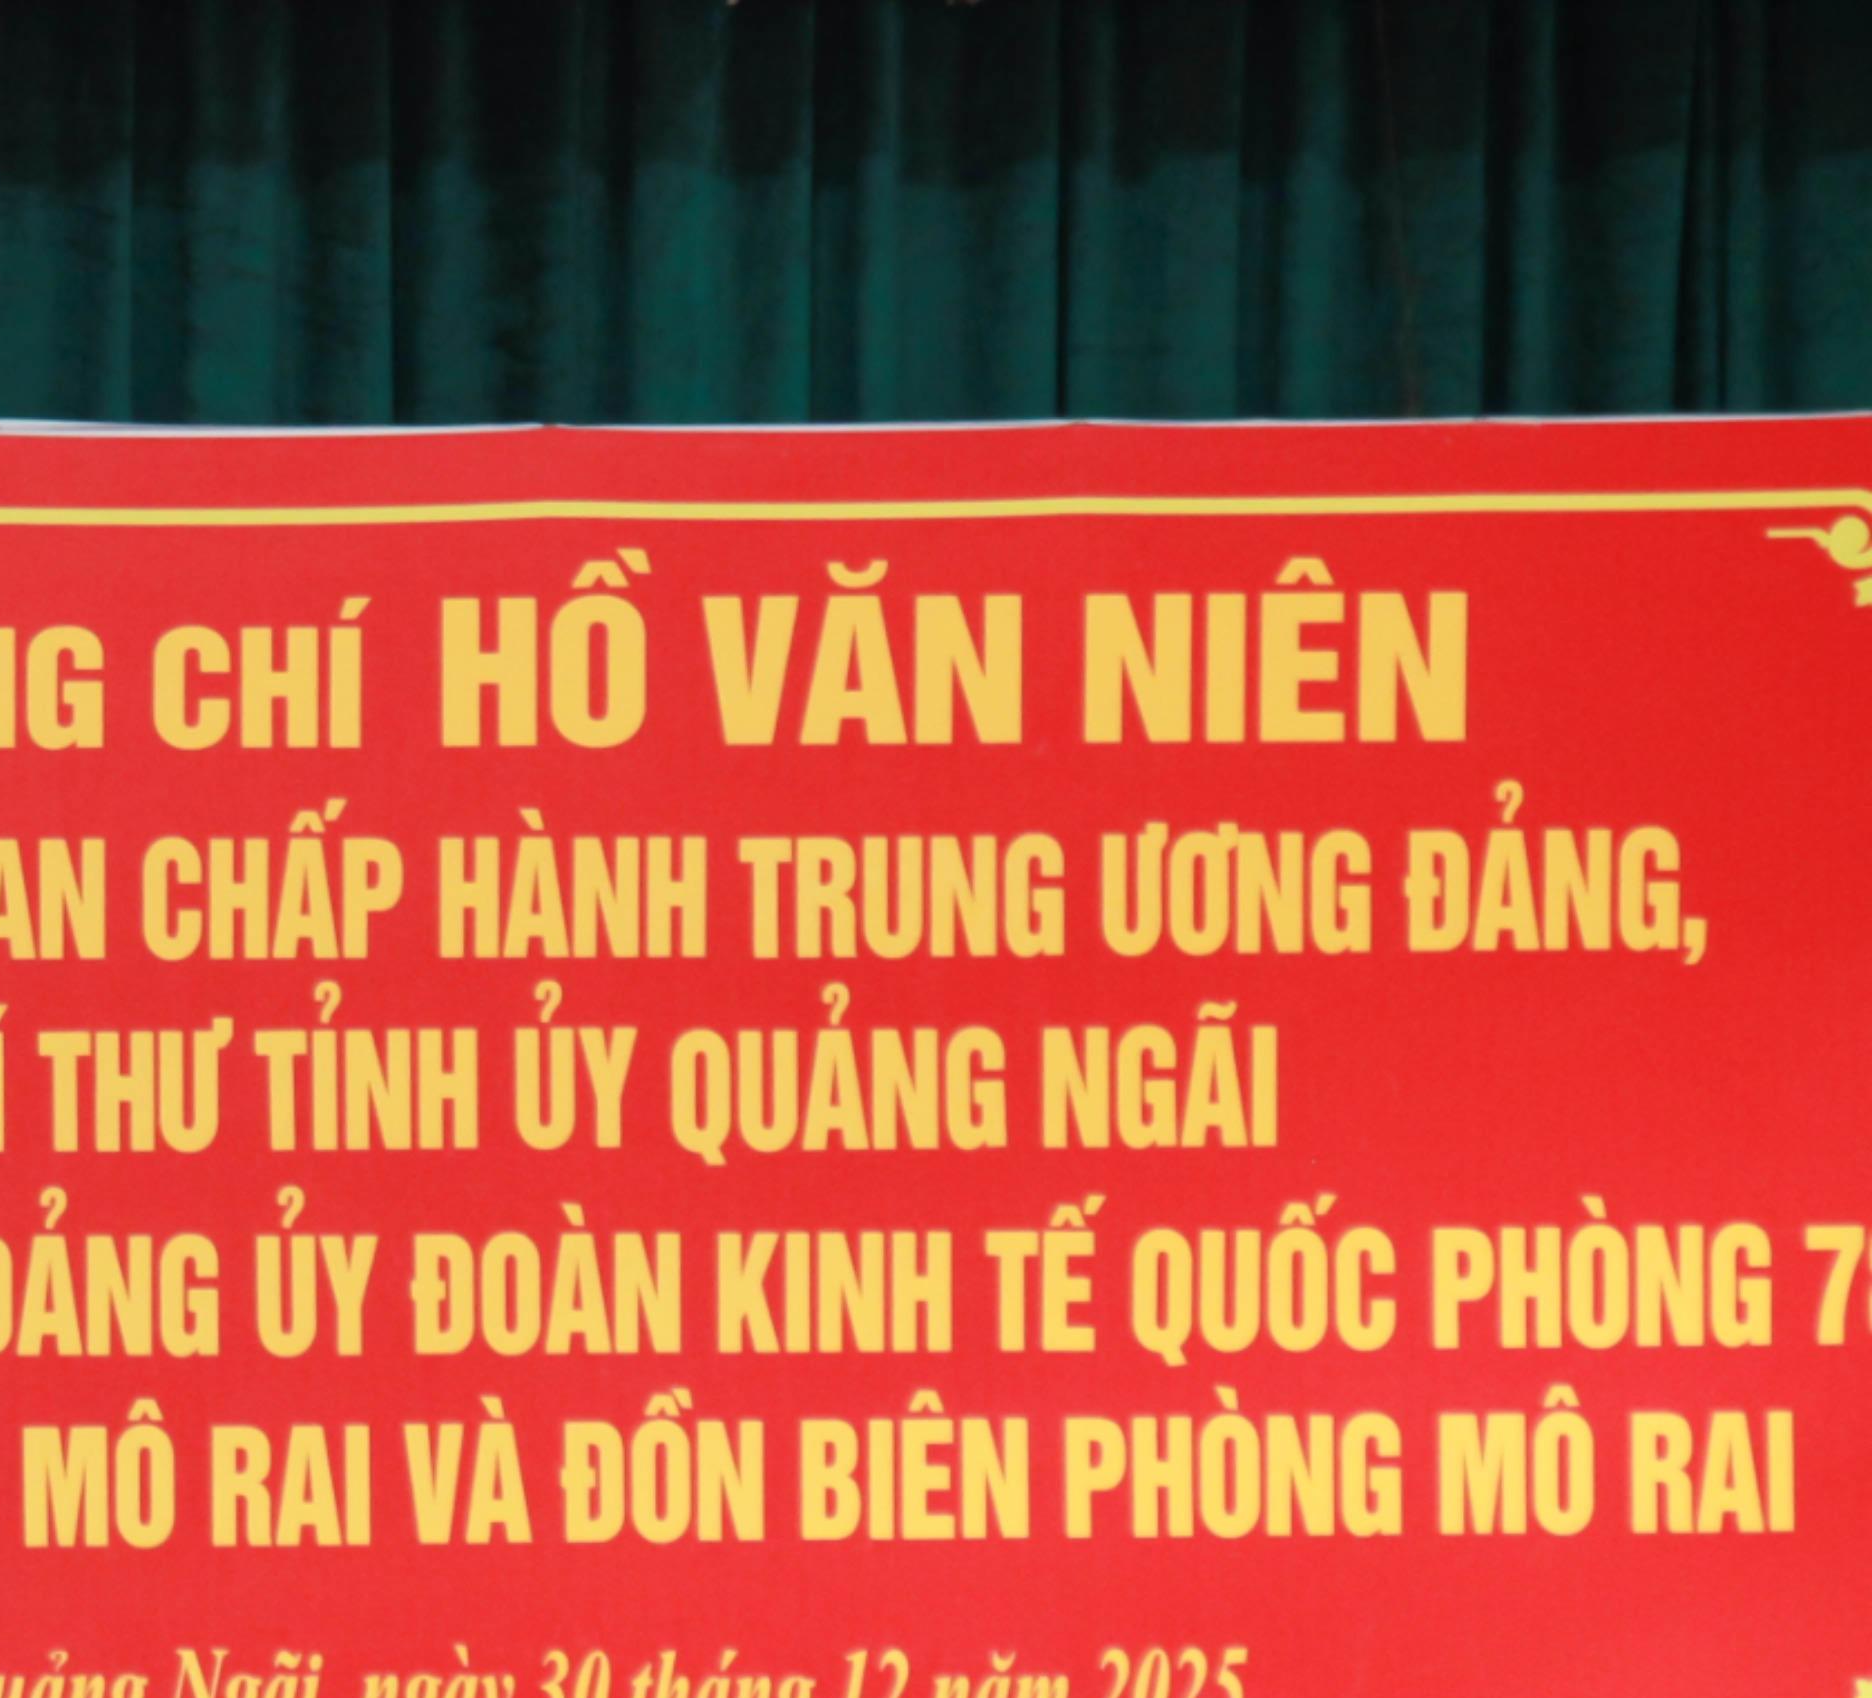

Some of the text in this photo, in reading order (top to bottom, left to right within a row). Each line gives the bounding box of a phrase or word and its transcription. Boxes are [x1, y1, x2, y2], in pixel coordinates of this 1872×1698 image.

[153, 597, 369, 750] CHÍ
[442, 548, 650, 748] HỒ
[703, 560, 1021, 746] VĂN
[1085, 557, 1466, 743] NIÊN
[143, 797, 403, 960] CHẤP
[440, 809, 706, 959] HÀNH
[739, 832, 1064, 959] TRUNG
[1102, 820, 1370, 957] ƯƠNG
[1405, 780, 1706, 966] ĐẢNG,
[38, 1016, 232, 1153] THƯ
[255, 980, 477, 1151] TỈNH
[515, 979, 636, 1151] ỦY
[671, 982, 1006, 1166] QUẢNG
[1043, 1001, 1276, 1150] NGÃI
[256, 1185, 377, 1358] ỦY
[410, 1202, 680, 1356] ĐOÀN
[717, 1230, 952, 1354] KINH
[985, 1194, 1105, 1352] TẾ
[1131, 1193, 1397, 1367] QUỐC
[1432, 1195, 1772, 1350] PHÒNG
[1804, 1224, 1872, 1346] 7
[22, 1397, 175, 1549] MÔ
[211, 1424, 371, 1547] RAI
[403, 1395, 532, 1545] VÀ
[559, 1387, 765, 1544] ĐỒN
[800, 1389, 1030, 1541] BIÊN
[1063, 1385, 1403, 1539] PHÒNG
[1437, 1383, 1595, 1536] MÔ
[1630, 1409, 1795, 1534] RAI
